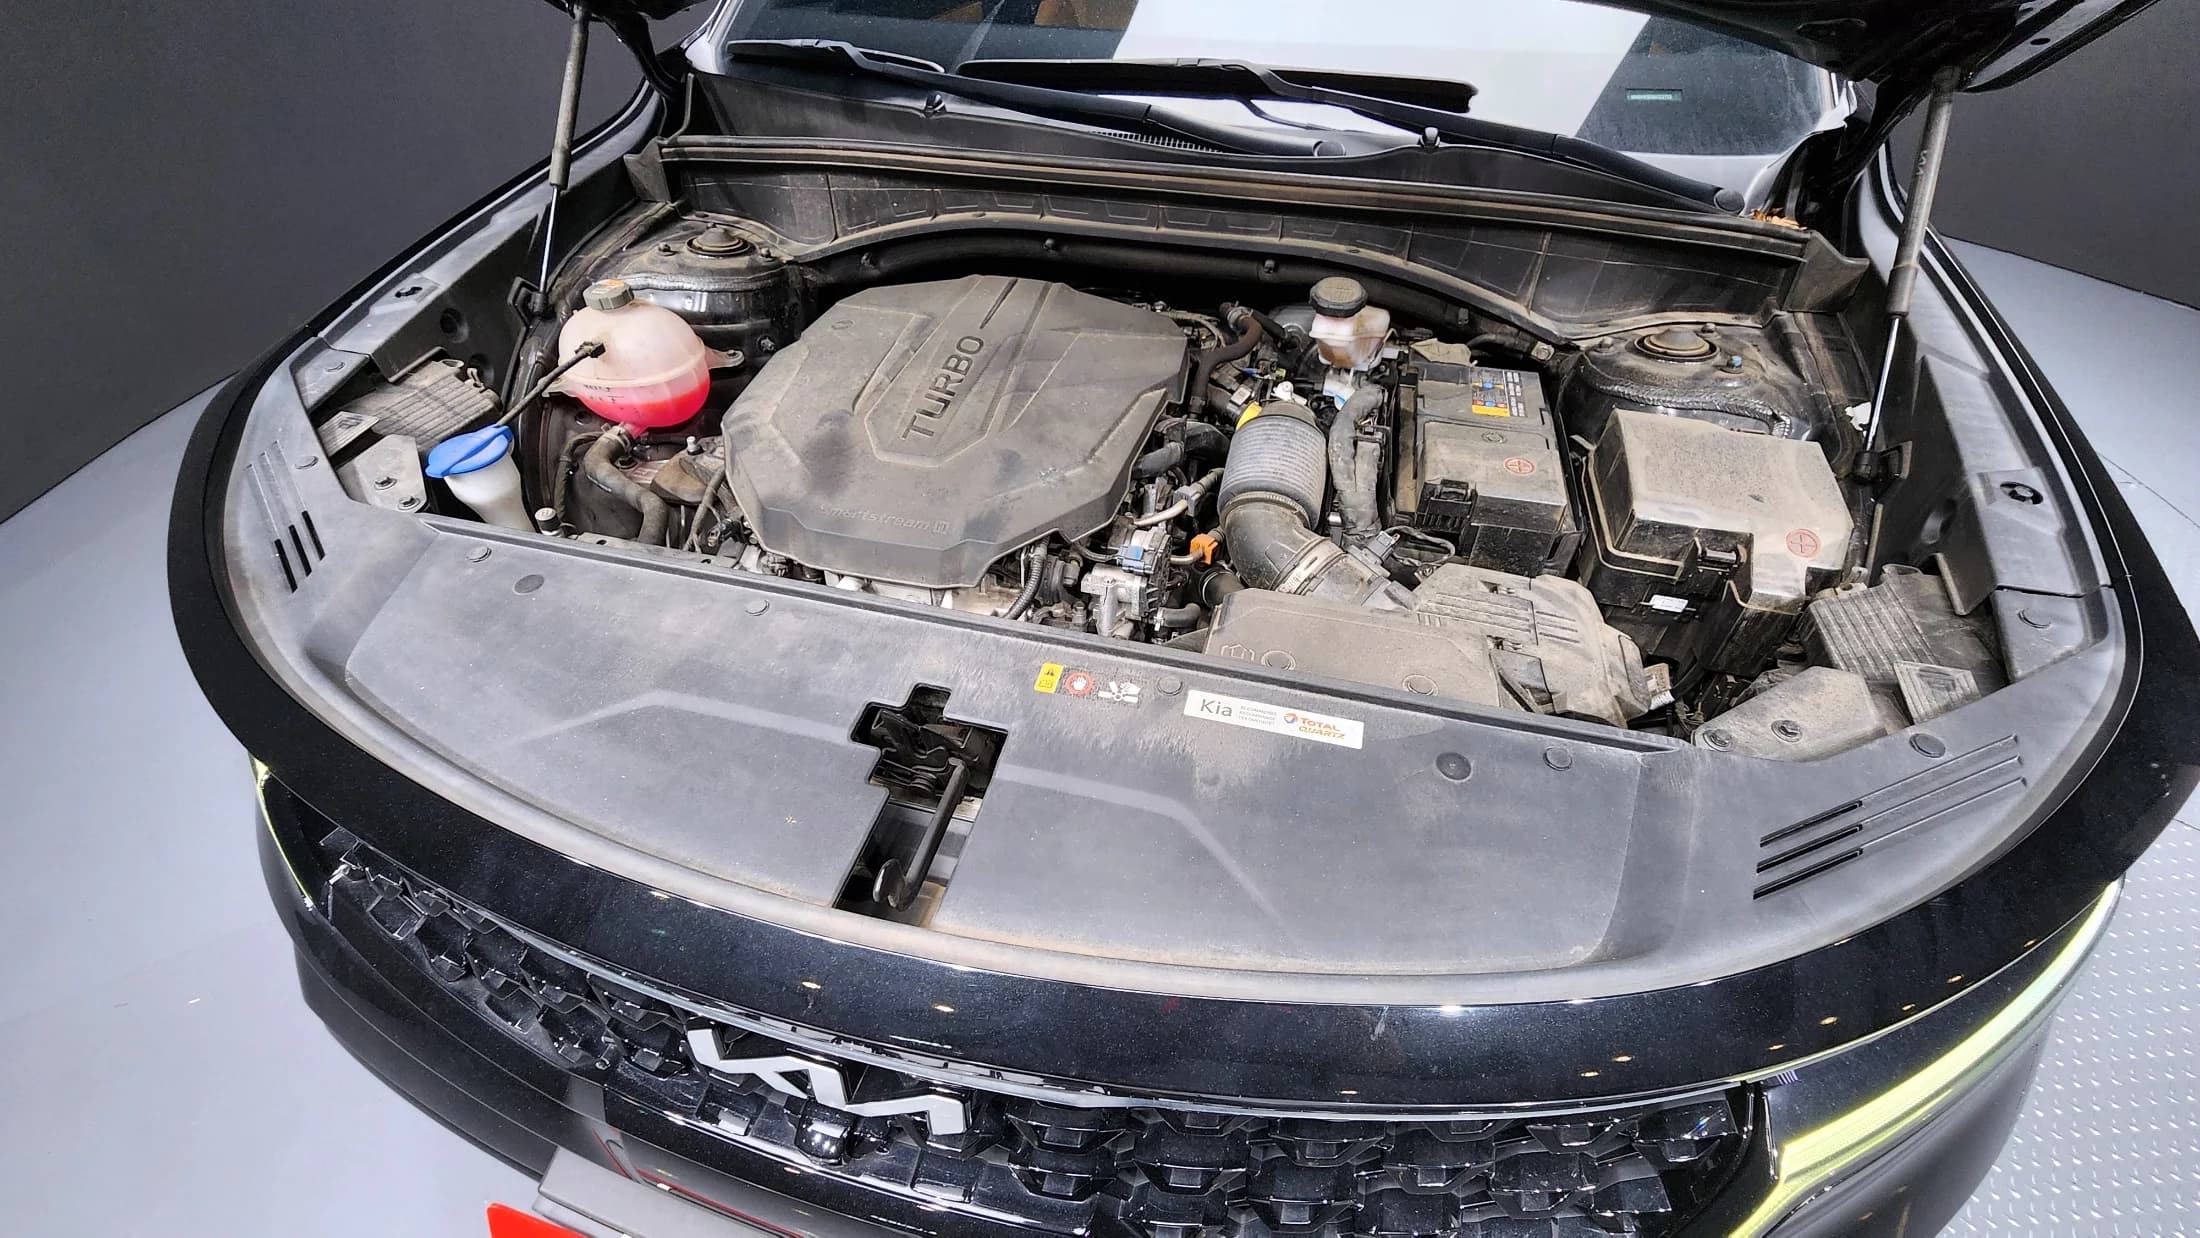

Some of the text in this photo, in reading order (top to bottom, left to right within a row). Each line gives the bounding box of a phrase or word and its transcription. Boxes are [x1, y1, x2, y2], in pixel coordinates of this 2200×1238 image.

[902, 335, 984, 438] TURBO
[1200, 698, 1233, 717] Kia
[1298, 725, 1346, 740] QUARTZ
[1299, 717, 1341, 731] TOTAL
